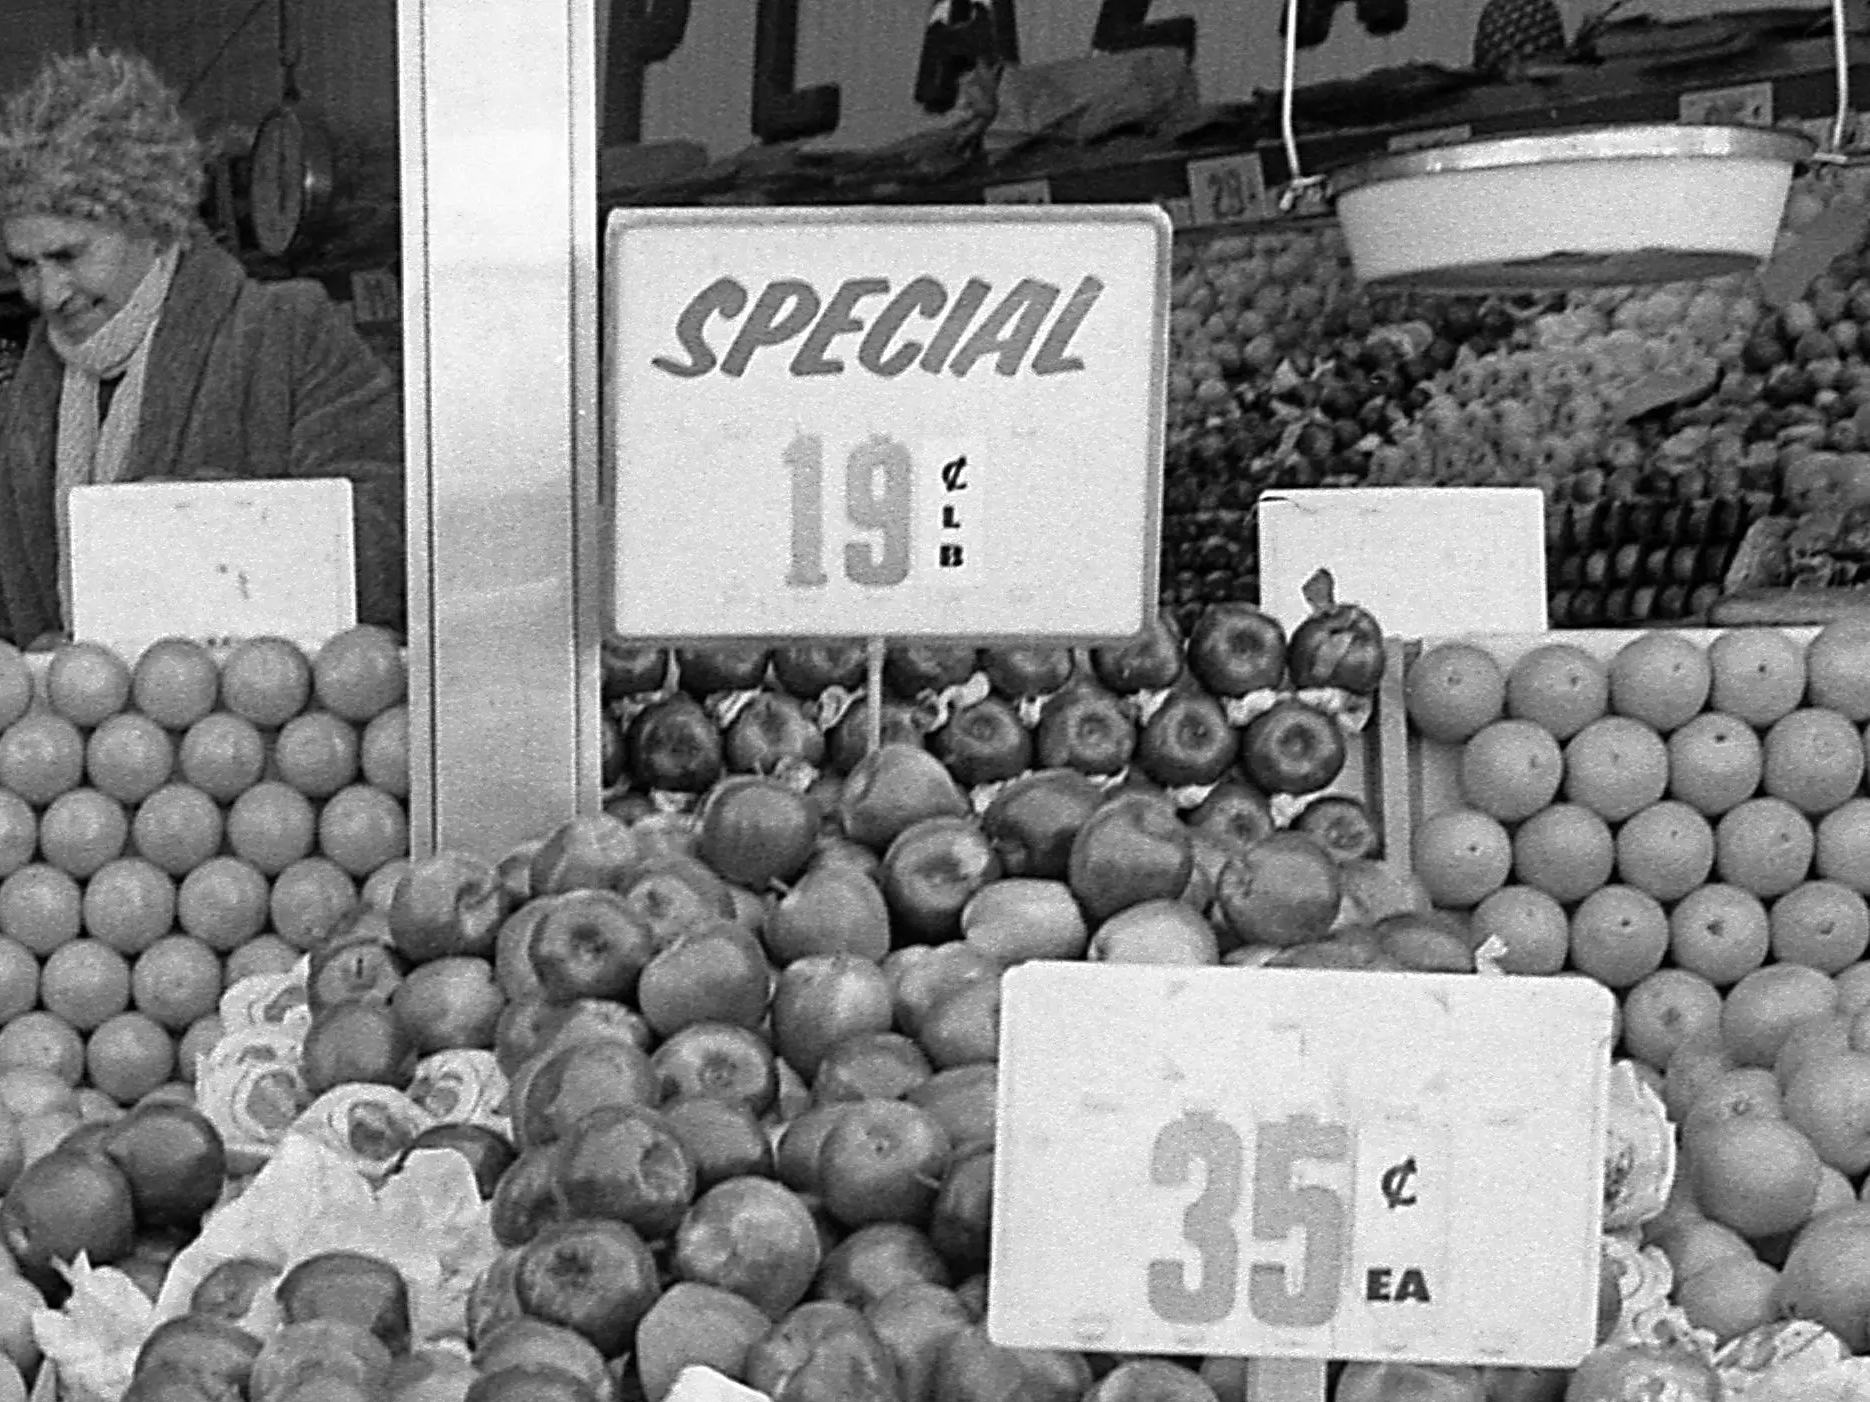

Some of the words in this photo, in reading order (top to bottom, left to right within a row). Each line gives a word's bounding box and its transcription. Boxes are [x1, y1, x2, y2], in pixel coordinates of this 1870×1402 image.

[602, 0, 1409, 144] PLA
[651, 275, 1105, 379] SPECIAL
[782, 432, 912, 588] 19
[1147, 1108, 1351, 1328] 35
[1366, 1268, 1431, 1303] EA
